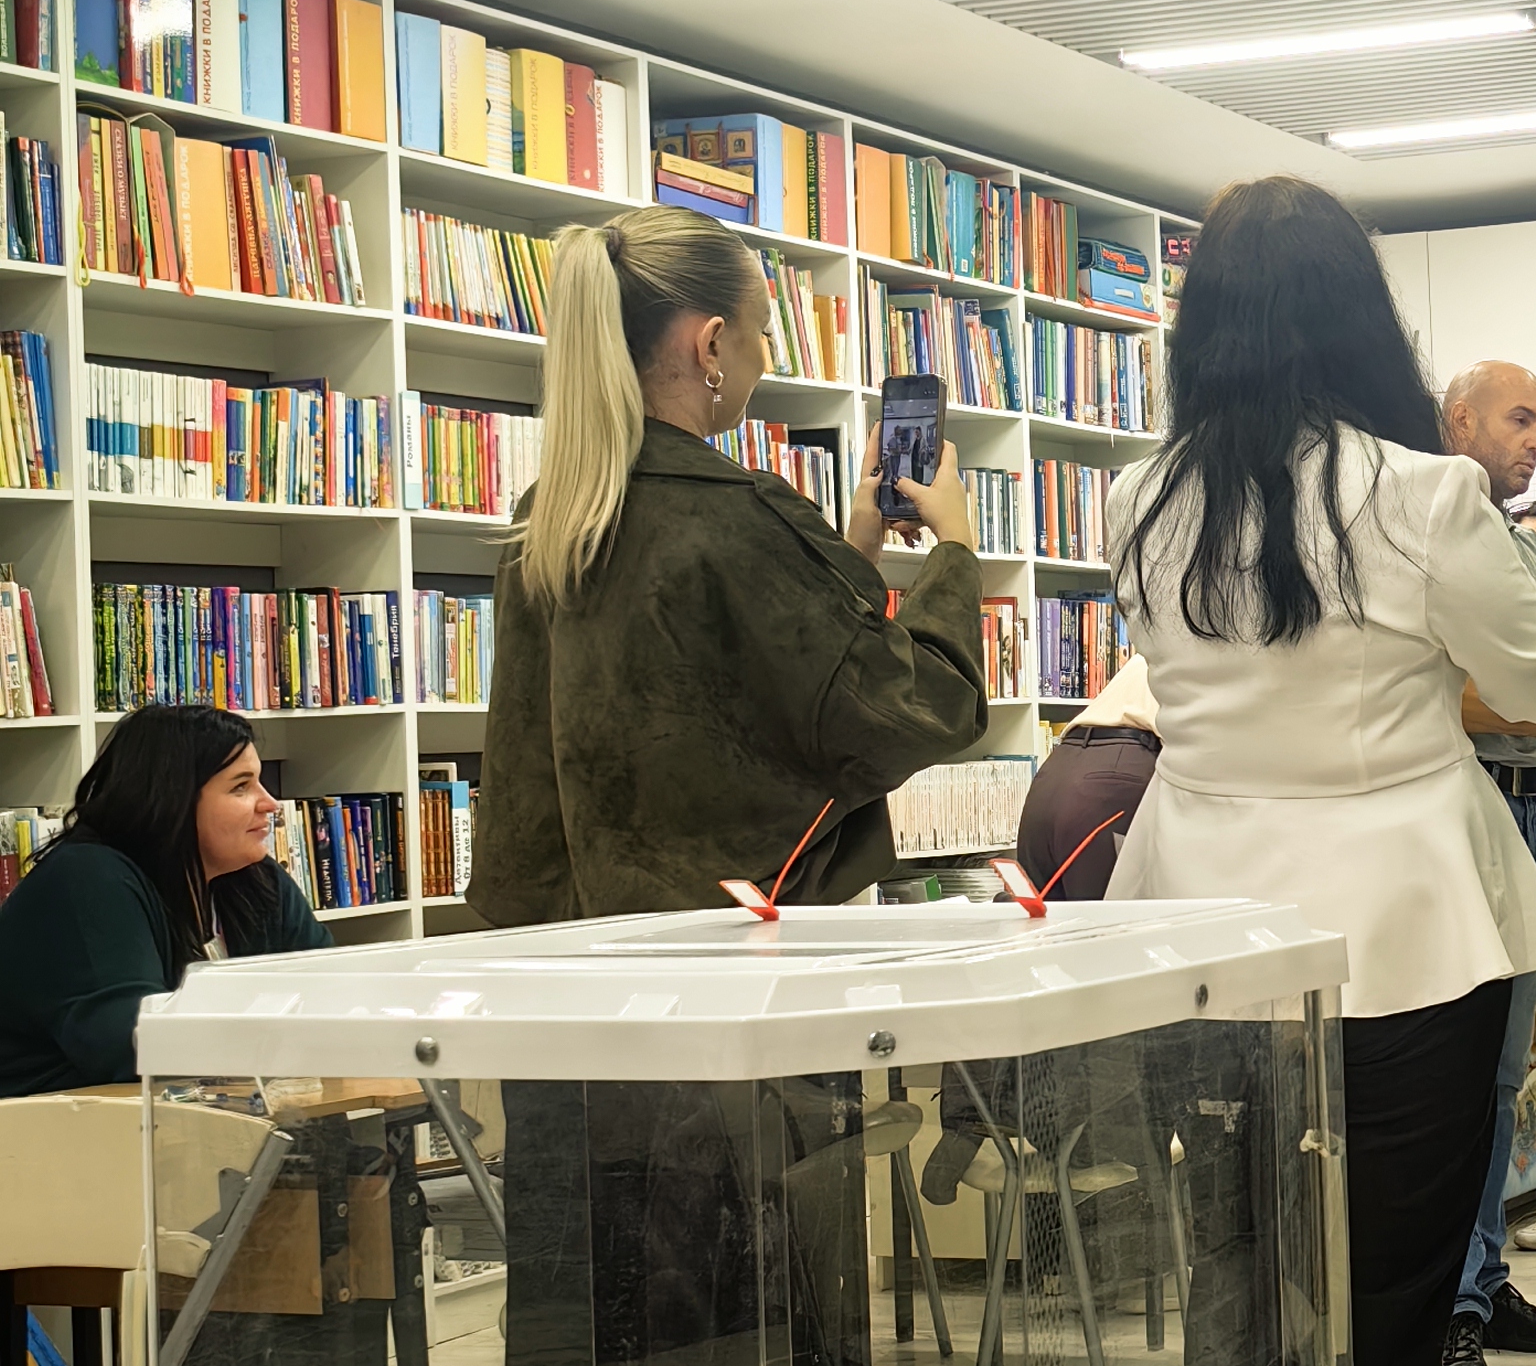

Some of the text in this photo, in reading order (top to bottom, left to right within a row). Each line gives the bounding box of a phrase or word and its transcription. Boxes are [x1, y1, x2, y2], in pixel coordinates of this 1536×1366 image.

[202, 48, 212, 105] КНИЖКИ
[449, 35, 458, 90] ПОДАРОК
[529, 58, 538, 110] ПОДАРОК
[291, 69, 302, 125] КНИЖКИ
[595, 85, 604, 134] ПОДАРОК
[114, 127, 124, 169] СКАЗКИ
[449, 102, 459, 150] КНИЖКИ
[530, 124, 540, 170] КНИЖКИ
[180, 145, 191, 209] ПОДАРОК
[597, 146, 605, 192] КНИЖКИ
[807, 134, 817, 182] ПОДАРОК
[819, 134, 828, 183] ПОДАРОК
[117, 180, 128, 221] МУЗЫКЕ
[240, 167, 260, 278] ЦАРЕВНА-ЛЯГУШКА
[808, 196, 818, 241] КНИЖКИ
[820, 196, 828, 241] КНИЖКИ
[183, 224, 194, 282] КНИЖКИ
[406, 415, 414, 468] Романы
[390, 605, 400, 659] Тенебрия
[454, 816, 462, 885] Детективы
[462, 819, 470, 833] 12
[464, 837, 471, 853] до
[462, 867, 471, 880] От
